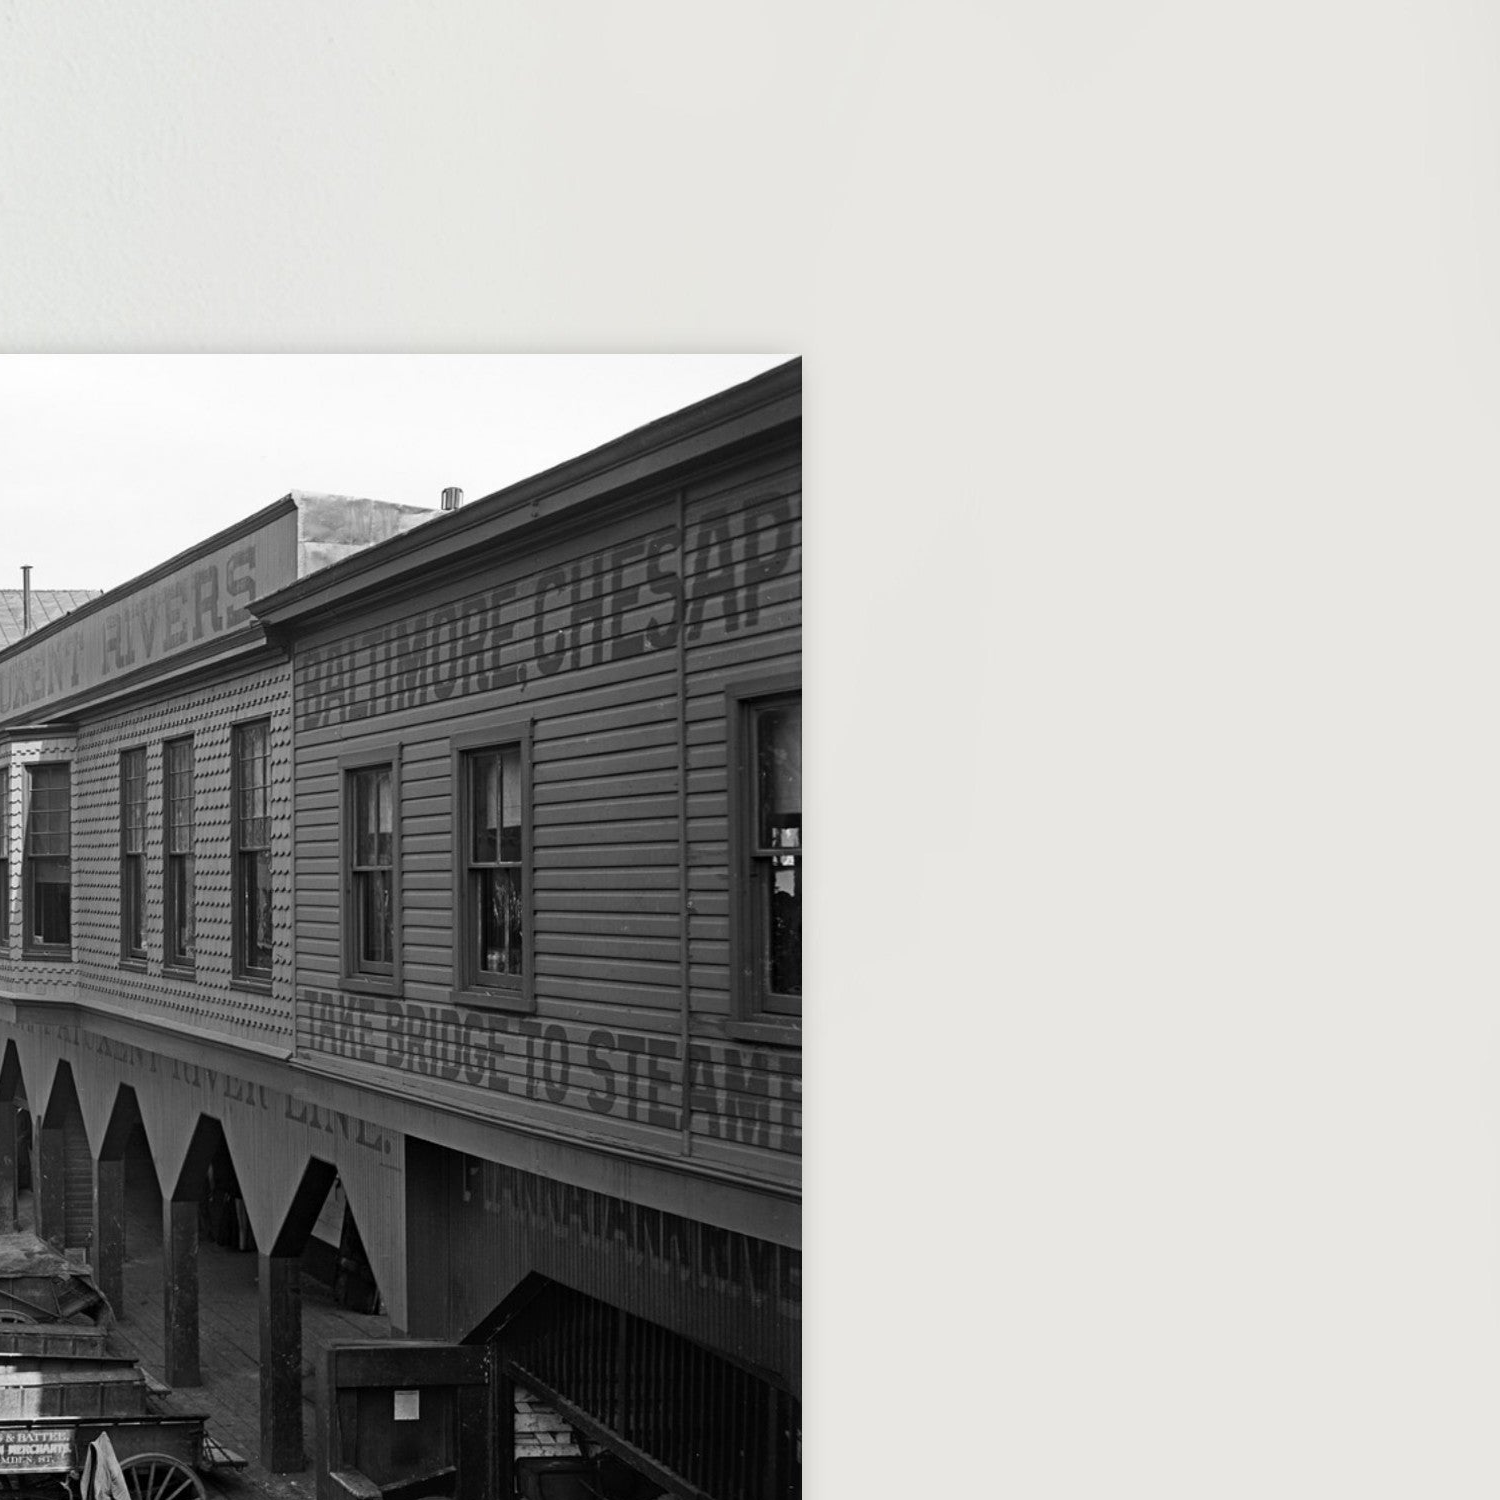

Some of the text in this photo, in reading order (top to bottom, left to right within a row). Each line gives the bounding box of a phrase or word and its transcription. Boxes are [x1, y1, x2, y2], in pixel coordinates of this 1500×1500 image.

[102, 545, 257, 676] RIVERS
[304, 991, 375, 1063] TAKE
[386, 1000, 510, 1089] BRIDGE
[520, 1019, 570, 1103] TO
[5, 1433, 14, 1443] &
